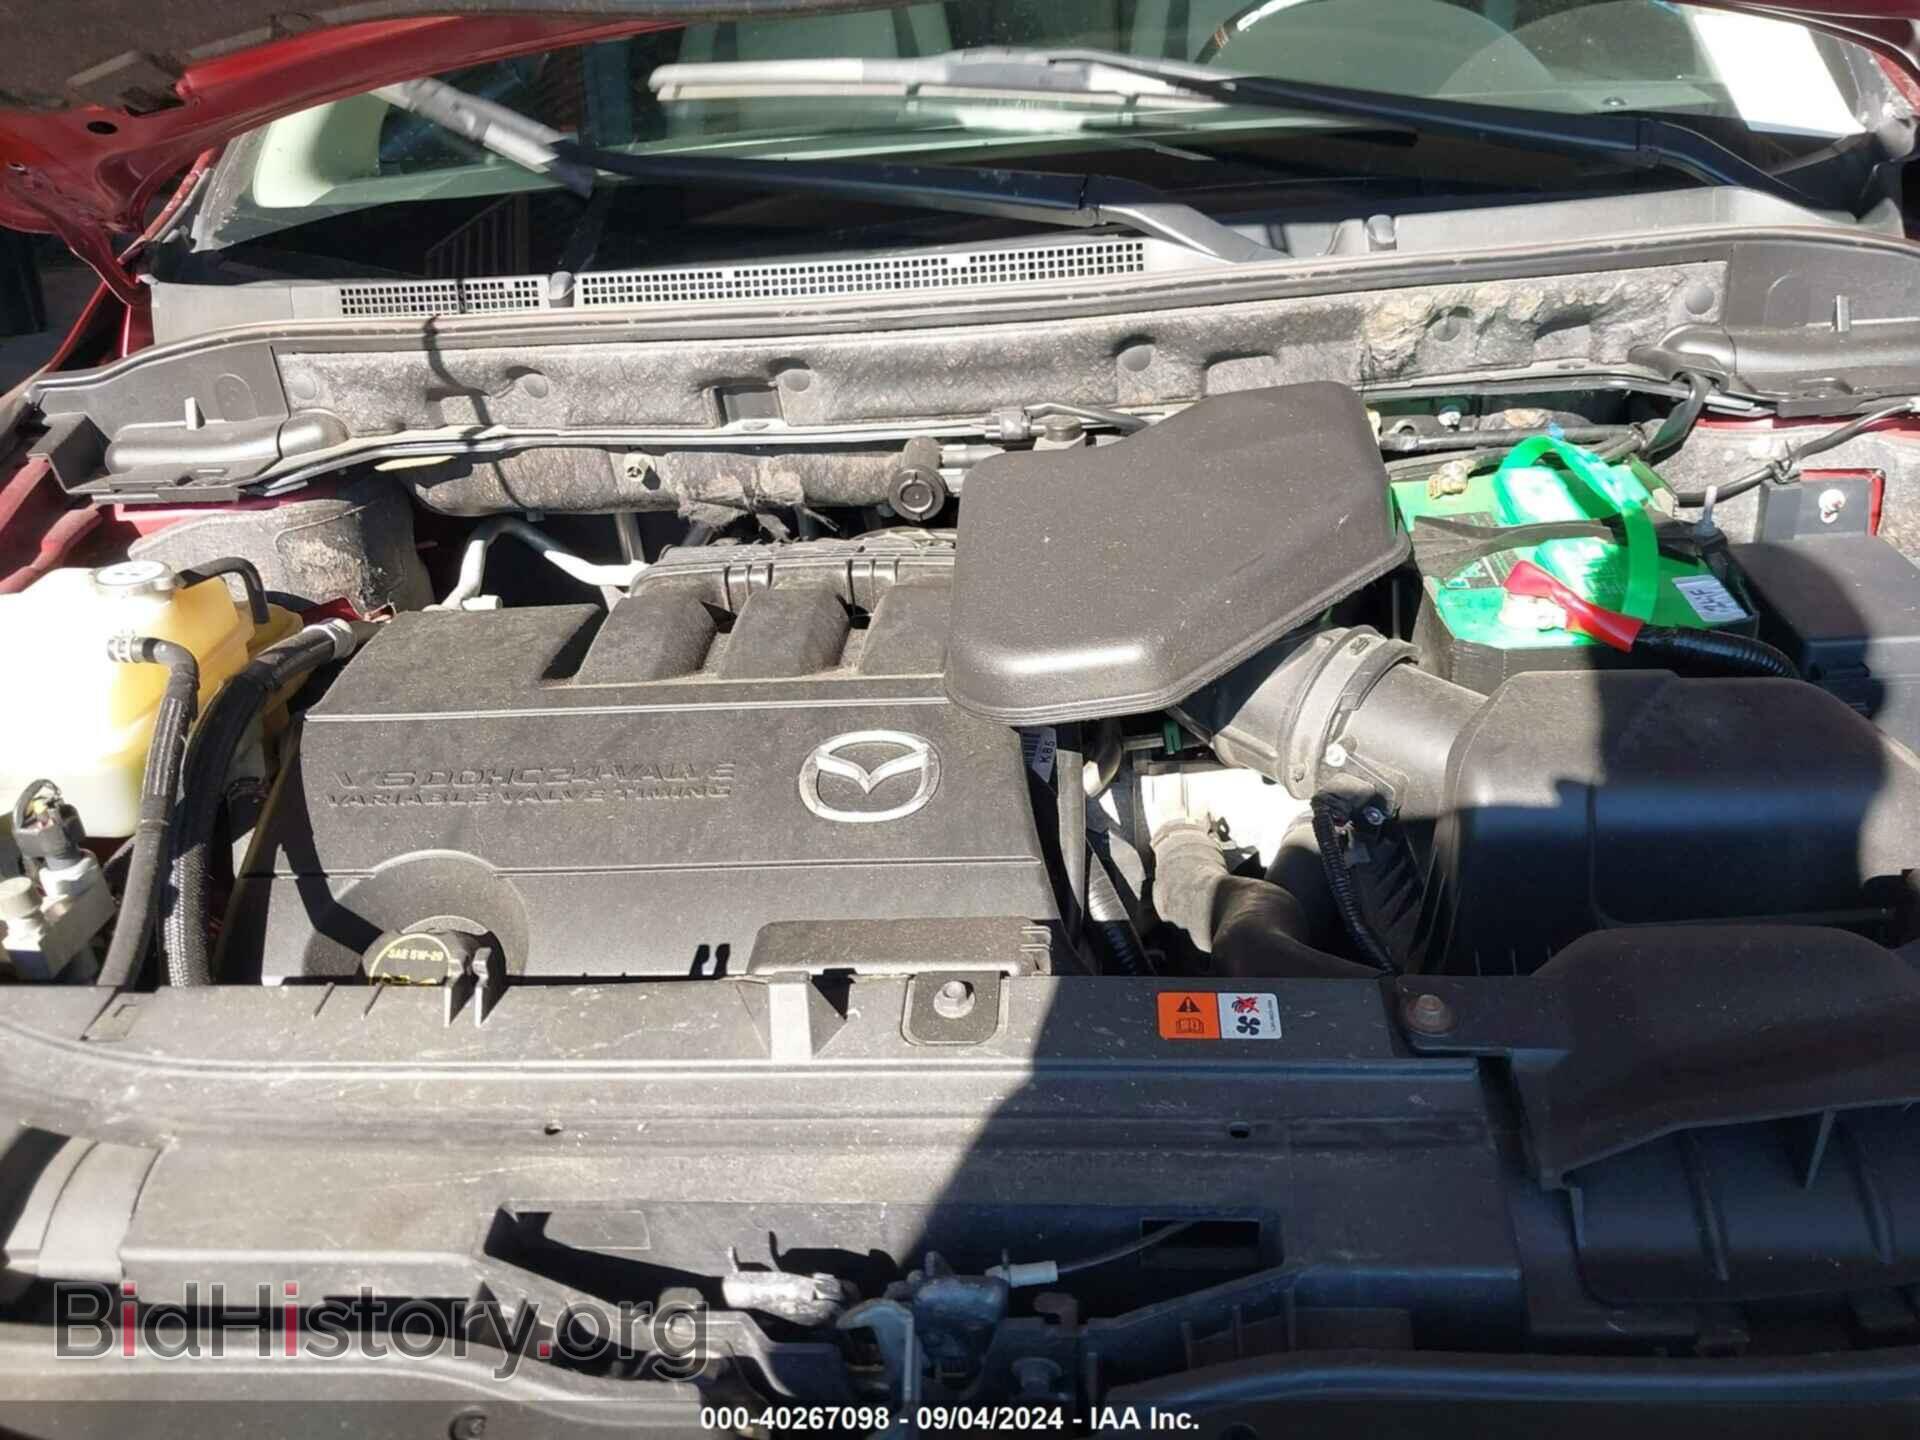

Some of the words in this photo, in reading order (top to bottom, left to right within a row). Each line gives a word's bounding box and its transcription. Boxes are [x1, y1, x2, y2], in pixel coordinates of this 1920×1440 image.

[419, 768, 544, 788] DOHC
[325, 792, 489, 807] VARIABLE
[497, 789, 604, 803] VALVE
[611, 784, 733, 800] TIMING
[387, 948, 410, 960] SAE
